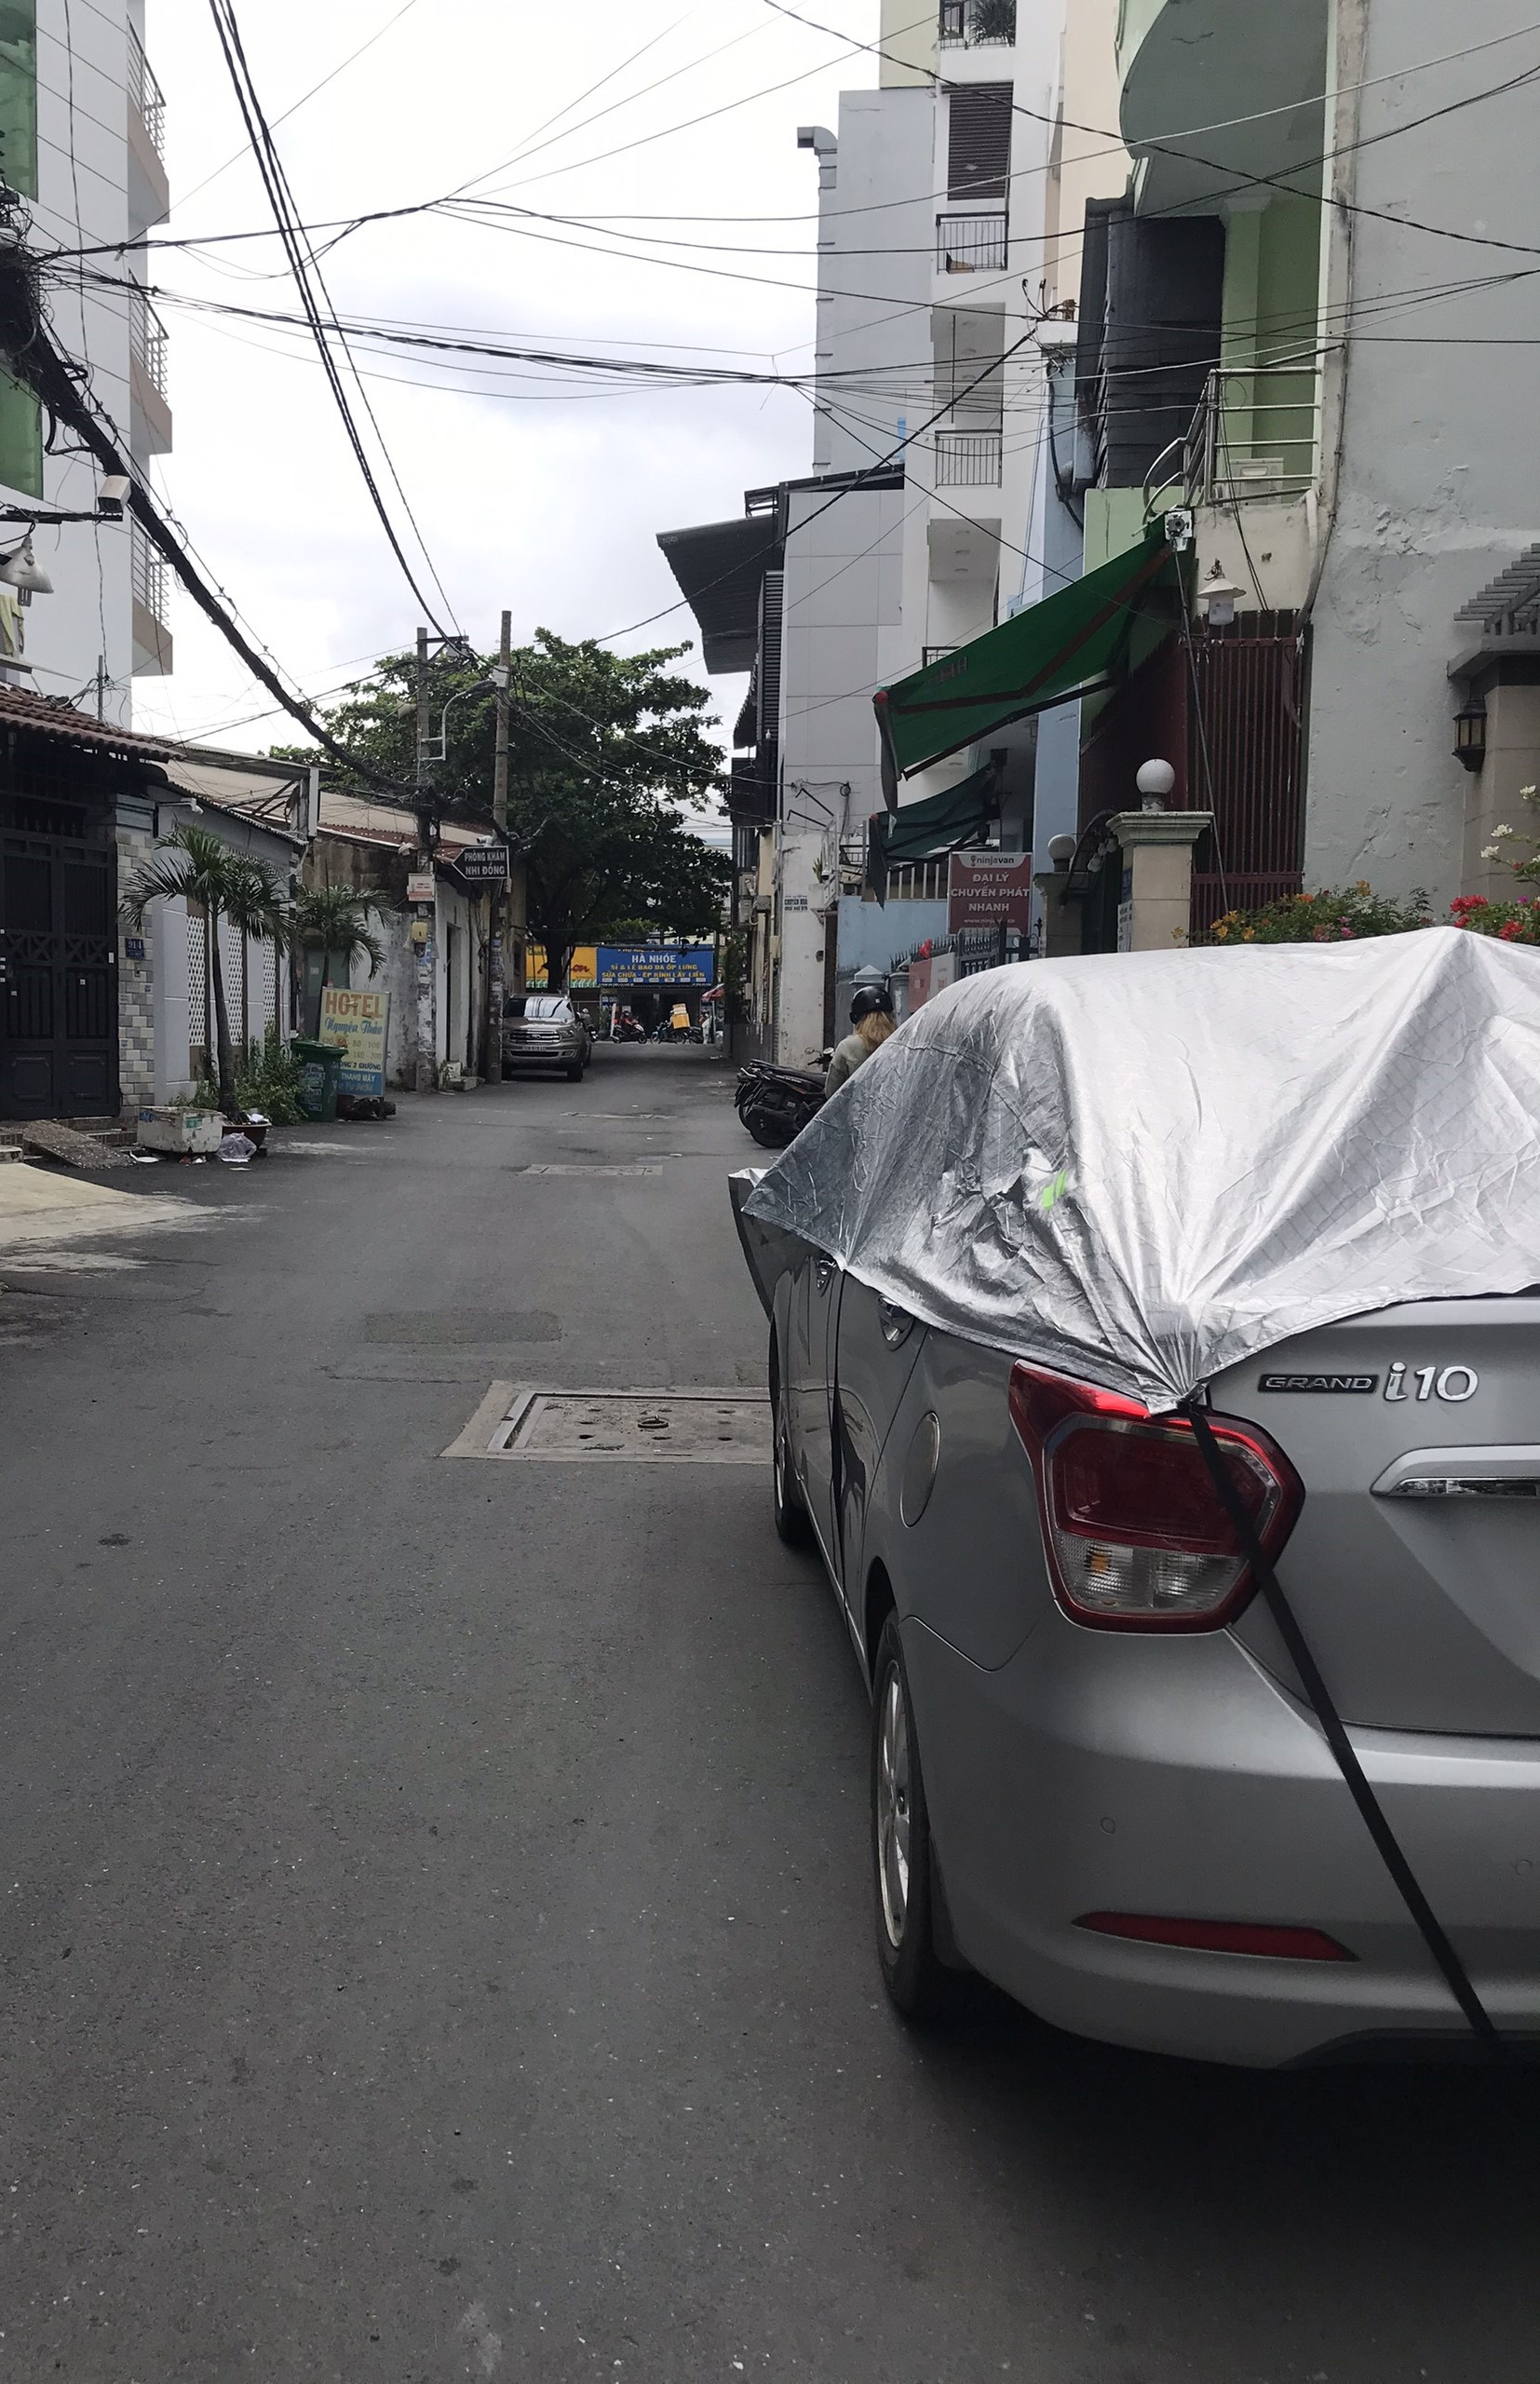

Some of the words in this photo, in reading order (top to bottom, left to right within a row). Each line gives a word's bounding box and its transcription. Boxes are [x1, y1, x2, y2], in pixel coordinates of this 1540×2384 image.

[464, 849, 486, 862] PHÒNG
[487, 849, 506, 861] KHÁM
[977, 855, 1014, 866] ninjavan
[466, 866, 480, 875] NHI
[481, 862, 506, 875] ĐỒNG
[973, 874, 993, 885] ĐẠI
[995, 872, 1010, 882] LÝ
[951, 885, 996, 897] CHUYỂN
[999, 887, 1030, 897] PHÁT
[968, 902, 1010, 912] NHANH
[632, 953, 646, 964] HÀ
[649, 953, 677, 964] NHÓE
[325, 992, 384, 1019] HOTEL
[1264, 1375, 1373, 1390] GRAND
[1384, 1361, 1479, 1402] i10
